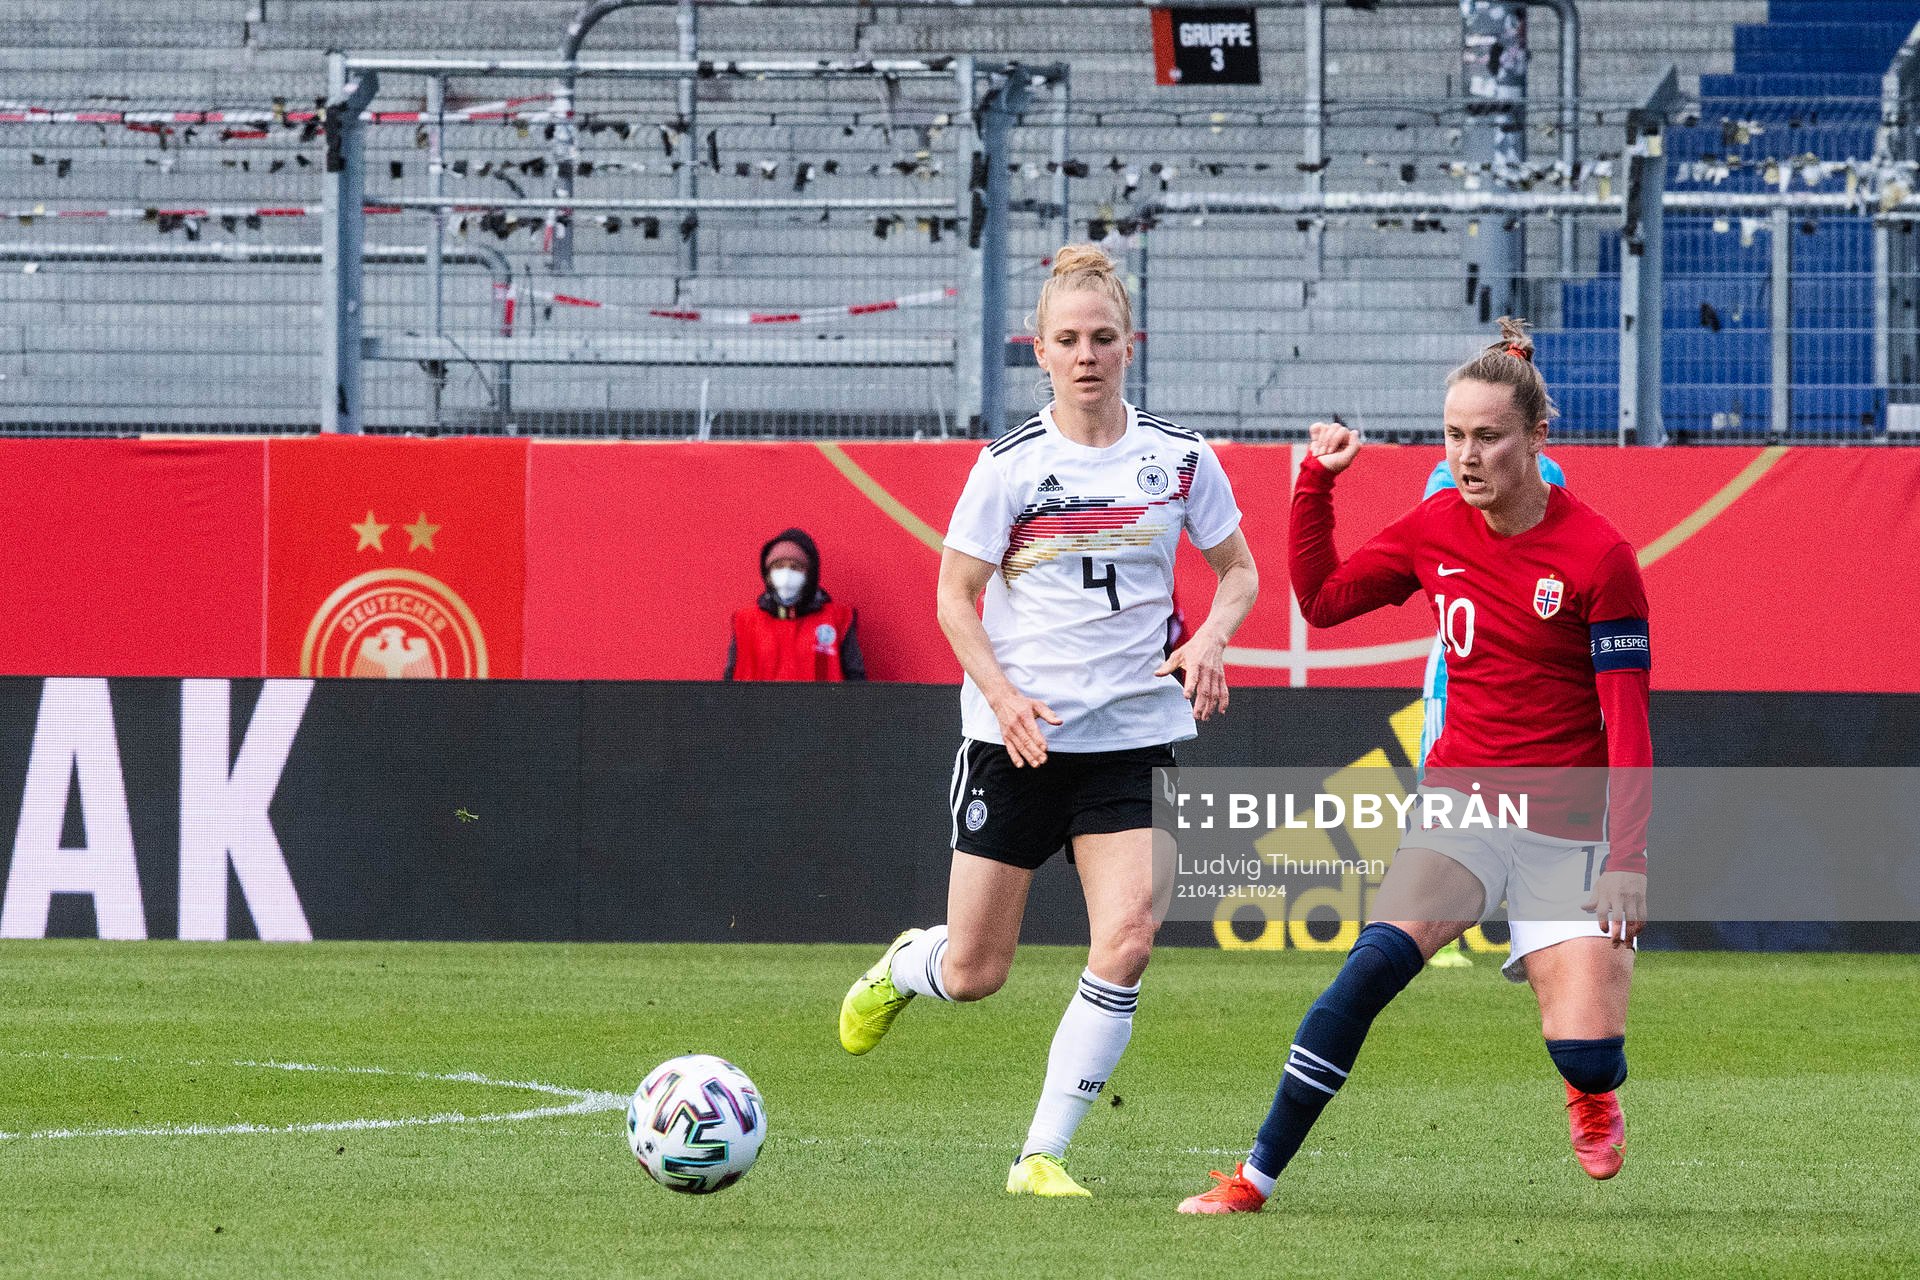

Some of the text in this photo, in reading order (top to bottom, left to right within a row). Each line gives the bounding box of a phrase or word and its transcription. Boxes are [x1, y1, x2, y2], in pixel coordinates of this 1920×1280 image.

[1179, 22, 1252, 47] GRUPPE
[1210, 47, 1225, 72] 3
[1082, 556, 1121, 611] 4
[341, 595, 447, 633] DEUTSCHER
[1435, 594, 1475, 658] 10
[1581, 845, 1610, 892] 1
